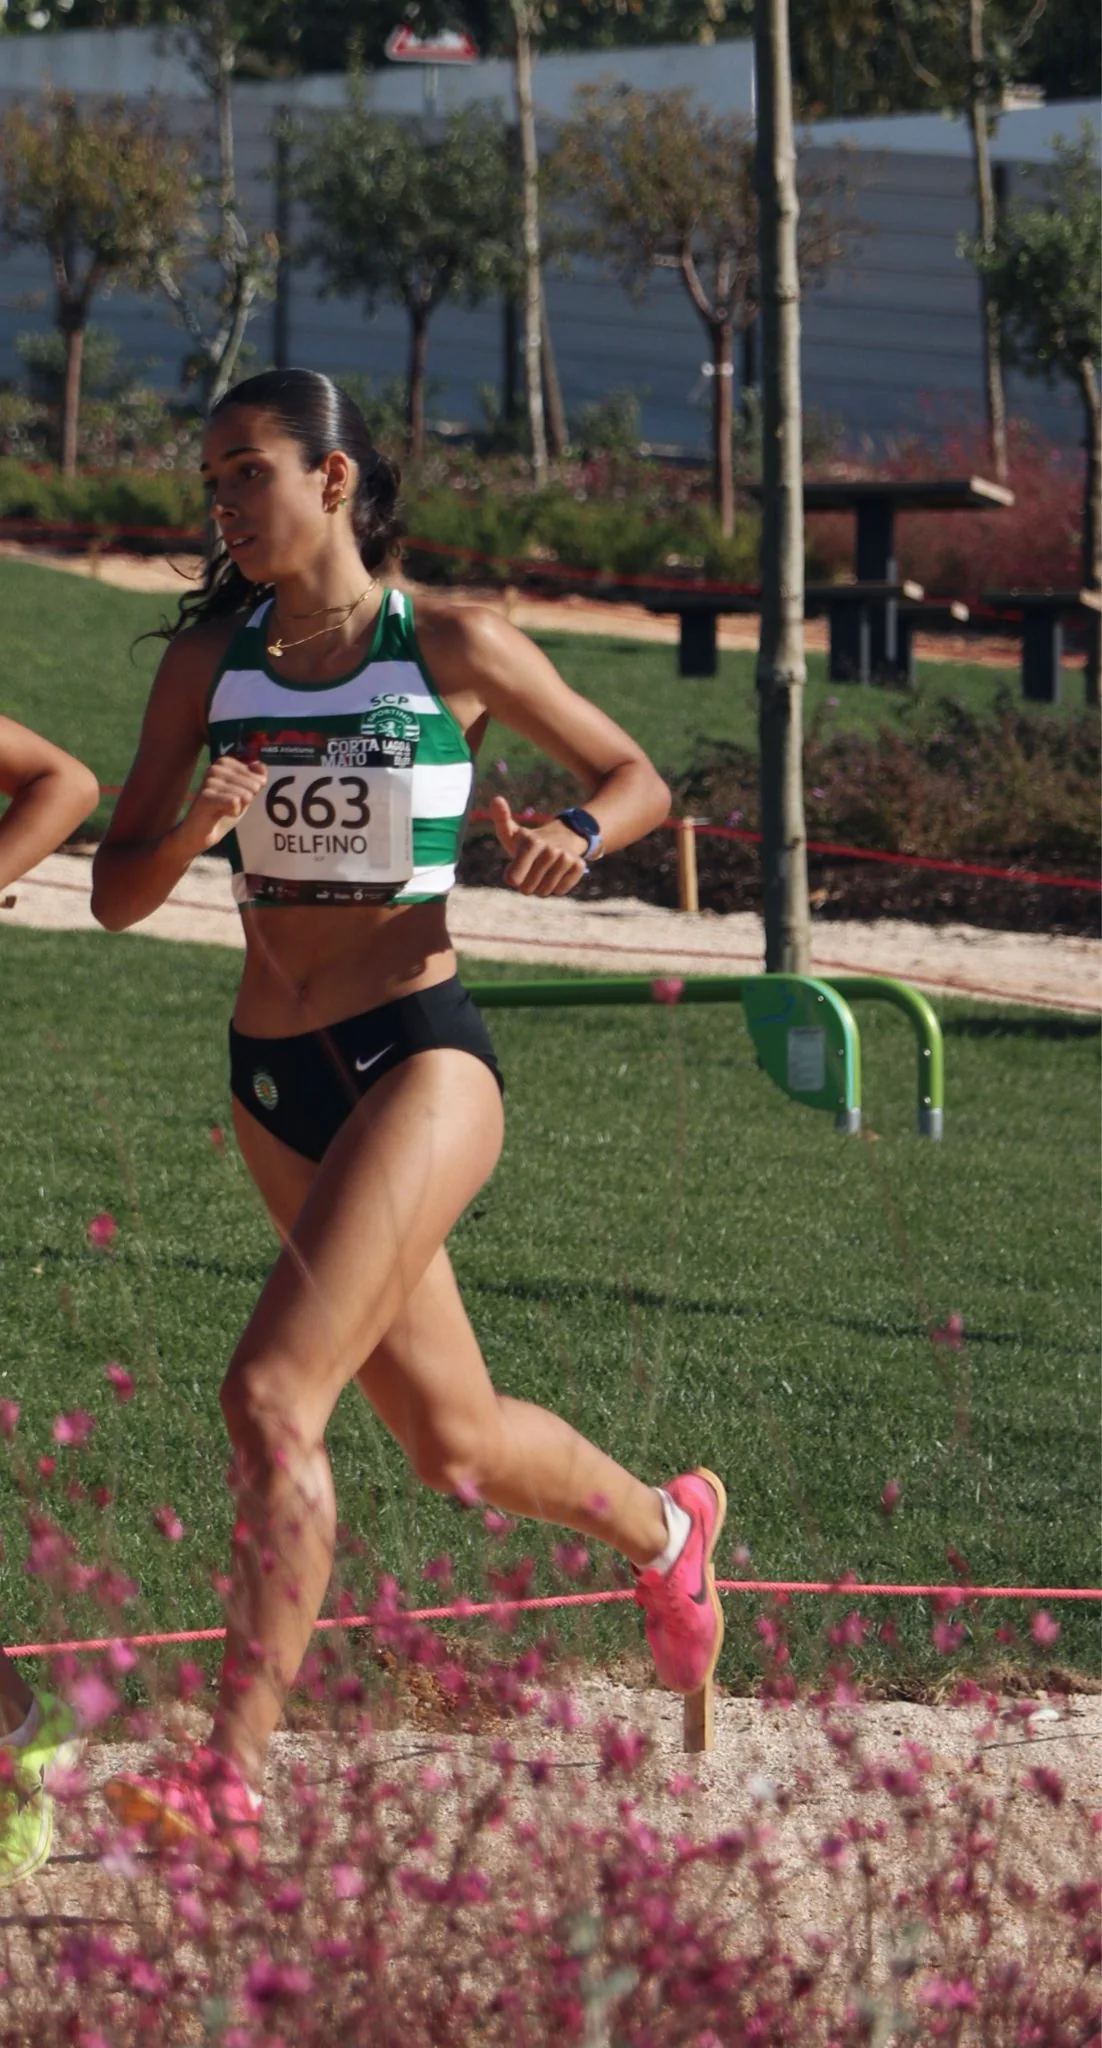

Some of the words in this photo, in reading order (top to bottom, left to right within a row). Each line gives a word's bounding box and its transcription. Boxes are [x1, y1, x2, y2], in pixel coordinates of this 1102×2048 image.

[370, 693, 409, 707] SCP
[366, 708, 413, 724] SPORTING
[327, 738, 380, 755] CORTA
[320, 752, 367, 768] MATO
[265, 775, 371, 829] 663
[274, 832, 367, 855] DELFINO
